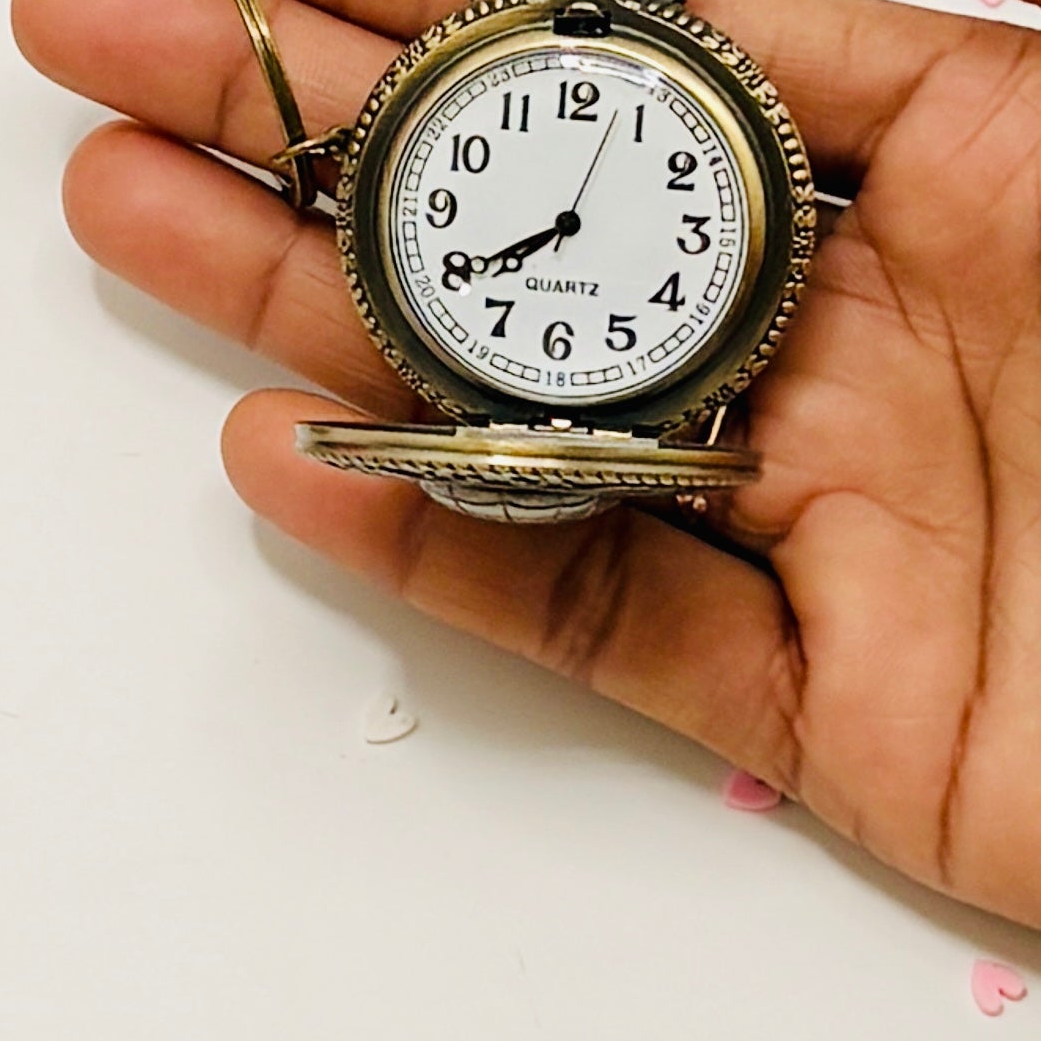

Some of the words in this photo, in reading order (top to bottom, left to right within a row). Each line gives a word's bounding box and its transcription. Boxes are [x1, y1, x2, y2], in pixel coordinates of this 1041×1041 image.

[500, 91, 531, 133] 11
[557, 80, 601, 122] 12
[427, 117, 449, 141] 22
[633, 103, 645, 143] 1
[450, 133, 491, 174] 10
[667, 151, 698, 191] 2
[402, 196, 419, 217] 21
[425, 188, 458, 229] 9
[676, 214, 711, 255] 3
[414, 275, 437, 299] 20
[441, 251, 472, 292] 8
[525, 276, 600, 297] QUARTZ
[647, 271, 686, 312] 4
[485, 296, 516, 338] 7
[605, 313, 638, 352] 5
[689, 302, 711, 326] 16
[467, 339, 490, 360] 19
[542, 320, 575, 361] 6
[545, 369, 566, 388] 18
[626, 355, 647, 376] 17
